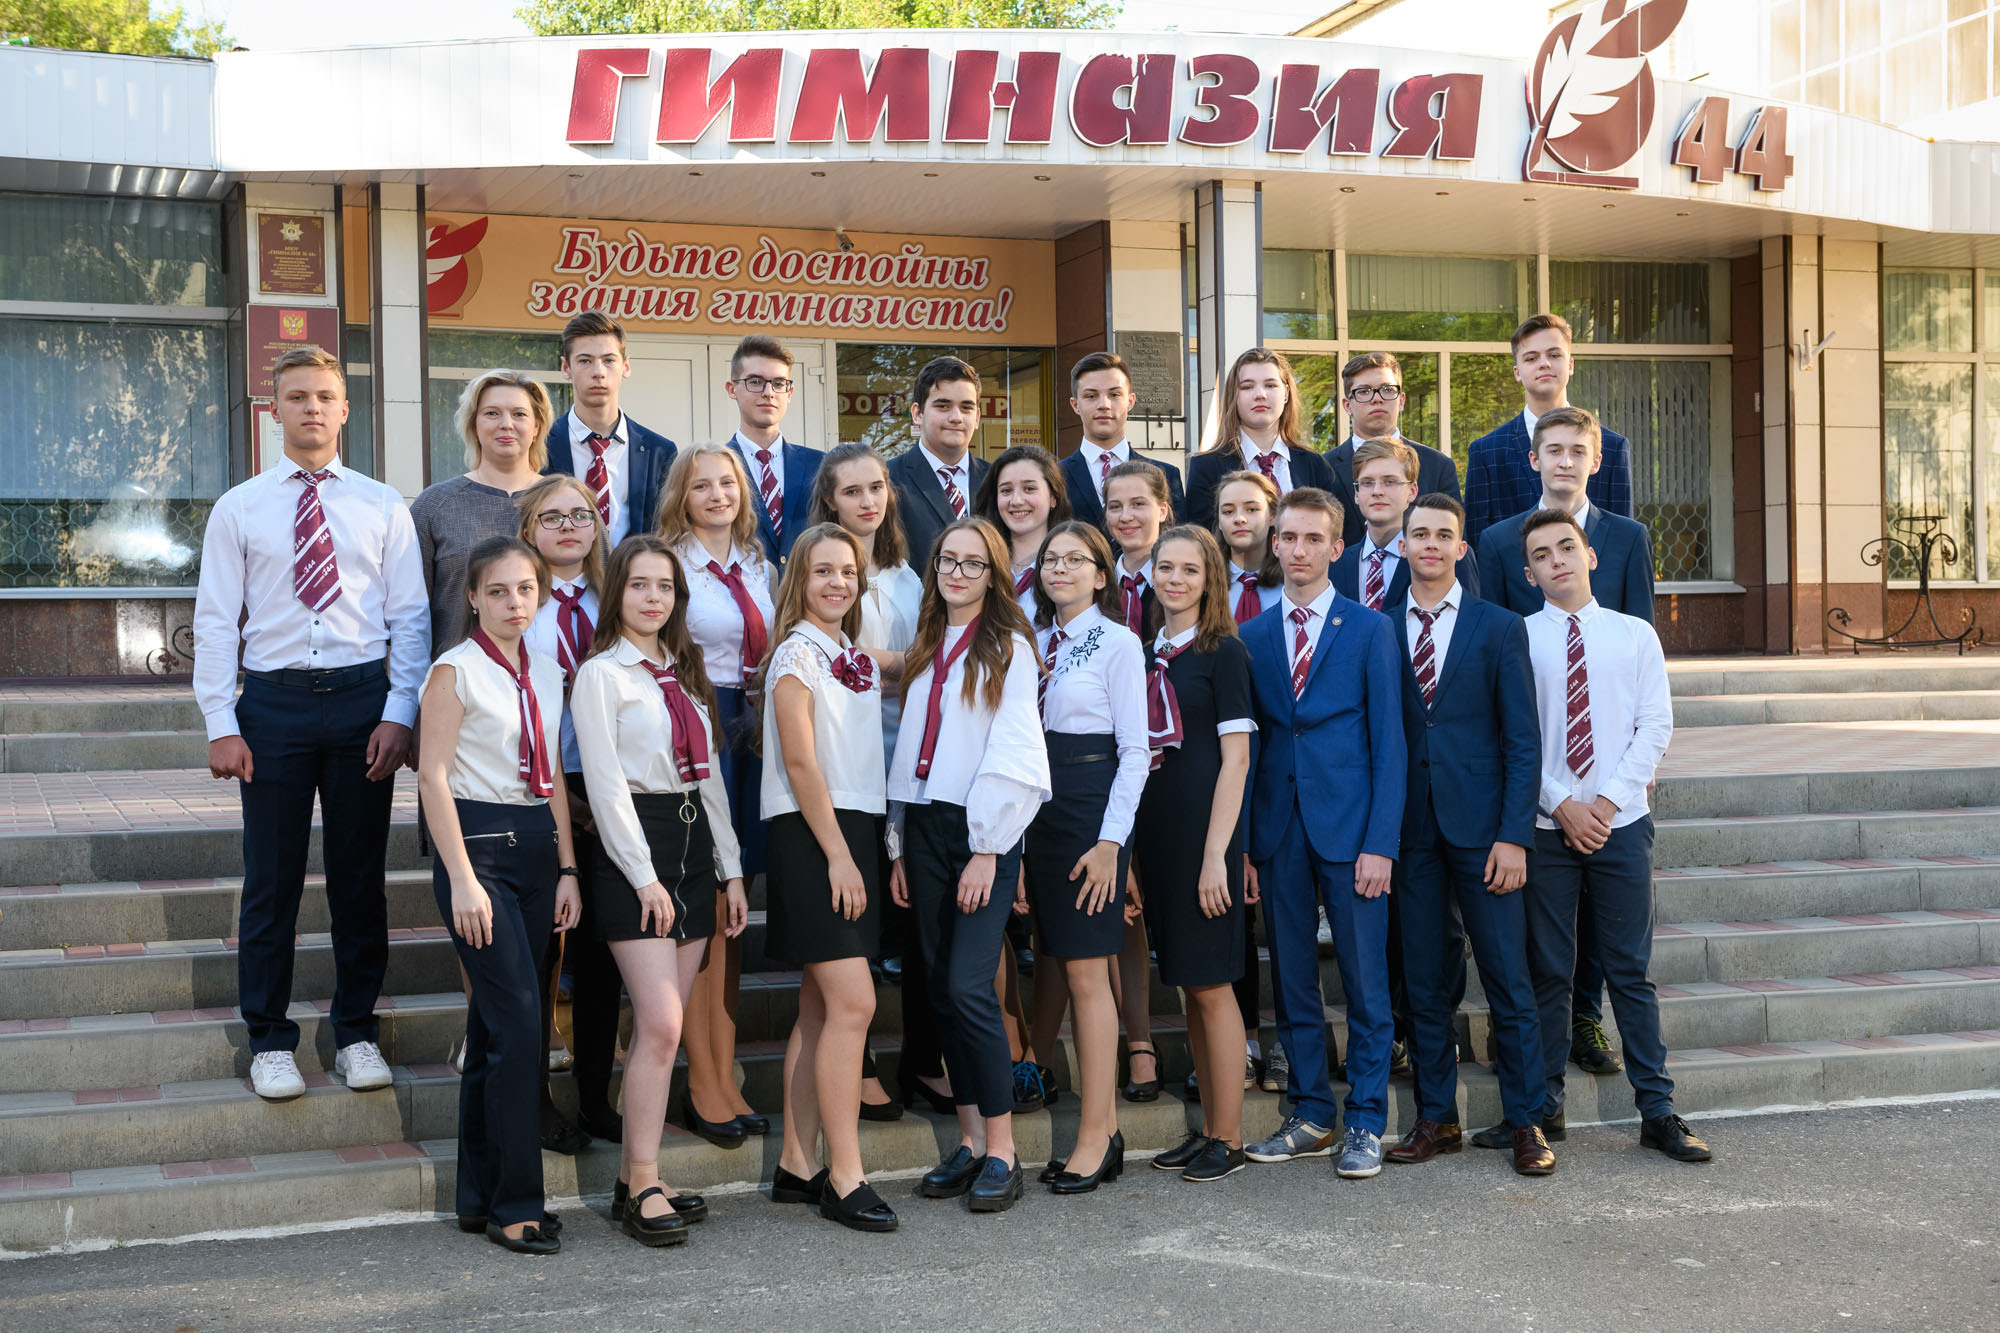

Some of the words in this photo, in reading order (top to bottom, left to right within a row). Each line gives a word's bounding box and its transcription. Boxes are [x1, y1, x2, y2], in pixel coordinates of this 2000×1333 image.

[1671, 96, 1794, 192] 44
[556, 227, 739, 283] Будьте
[751, 236, 989, 288] достойны
[530, 281, 697, 318] звания
[711, 288, 1013, 330] гимназиста!
[1010, 428, 1041, 436] ОДИТЕЛ
